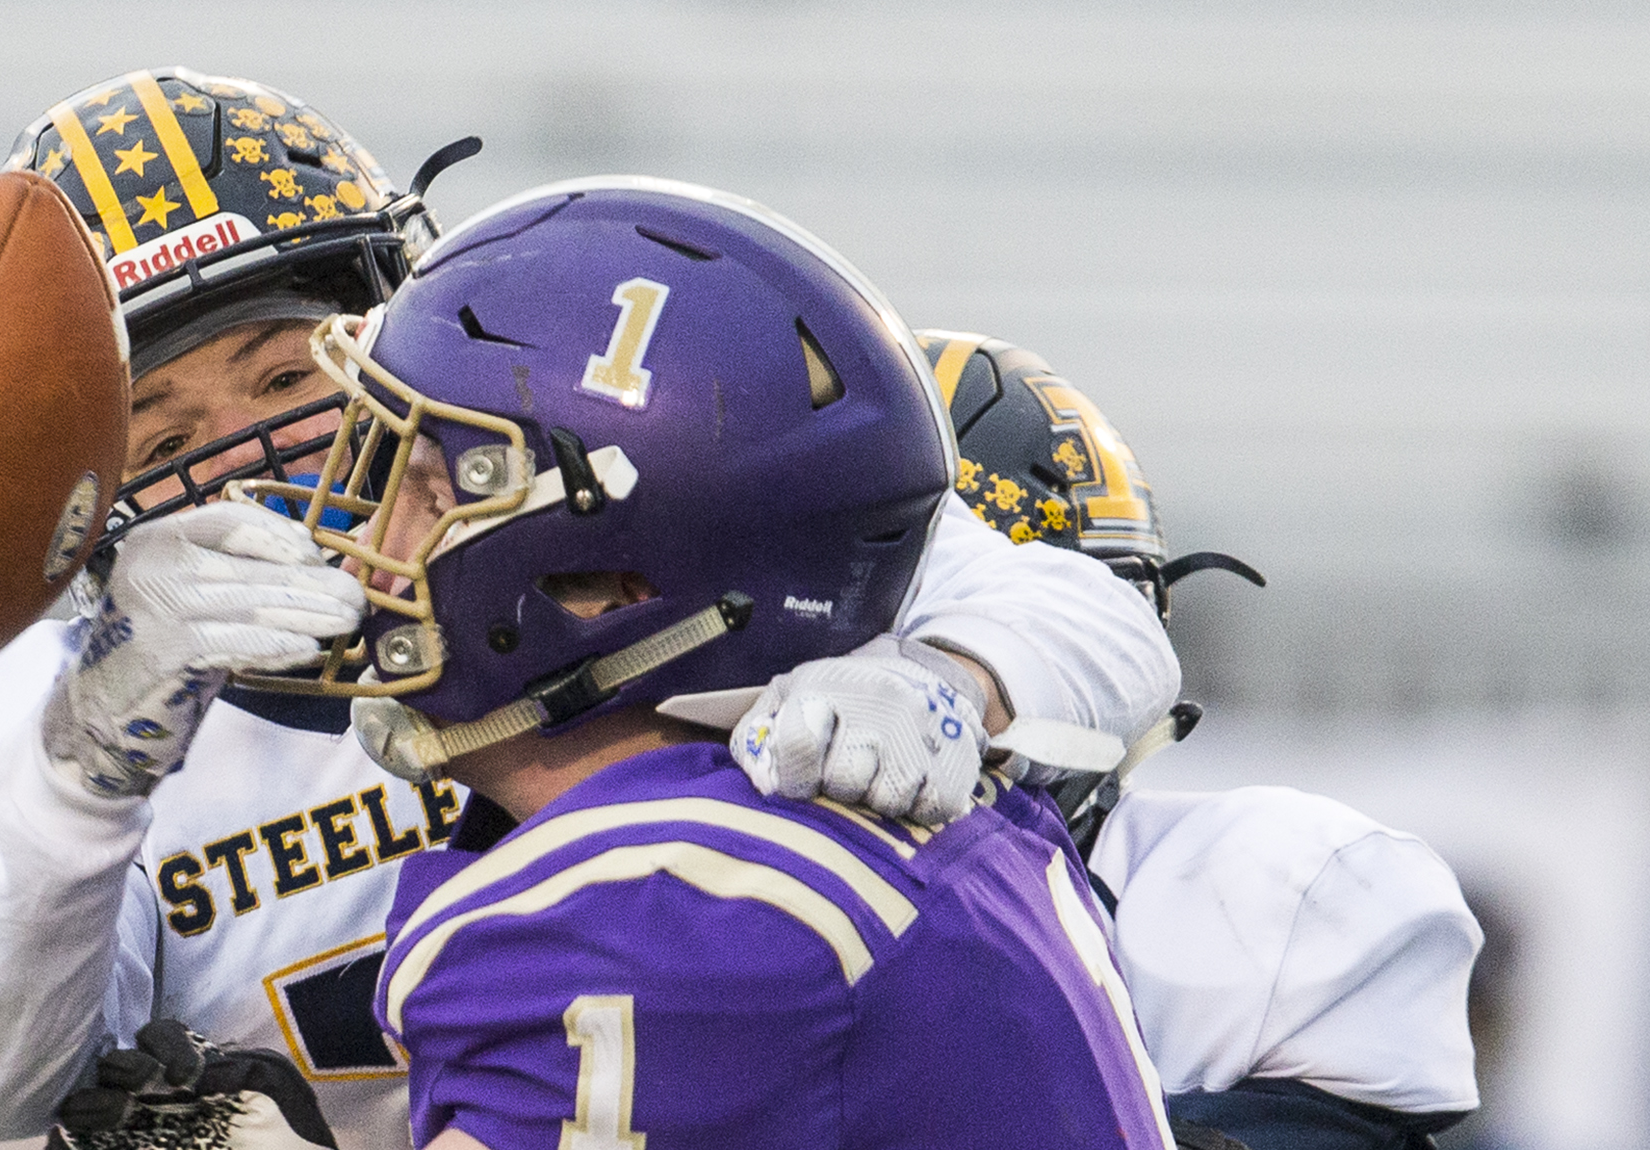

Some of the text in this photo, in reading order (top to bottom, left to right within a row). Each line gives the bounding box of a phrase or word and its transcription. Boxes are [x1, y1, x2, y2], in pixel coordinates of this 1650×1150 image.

[113, 221, 240, 288] Riddell
[581, 277, 670, 408] 1
[783, 595, 833, 615] Riddell
